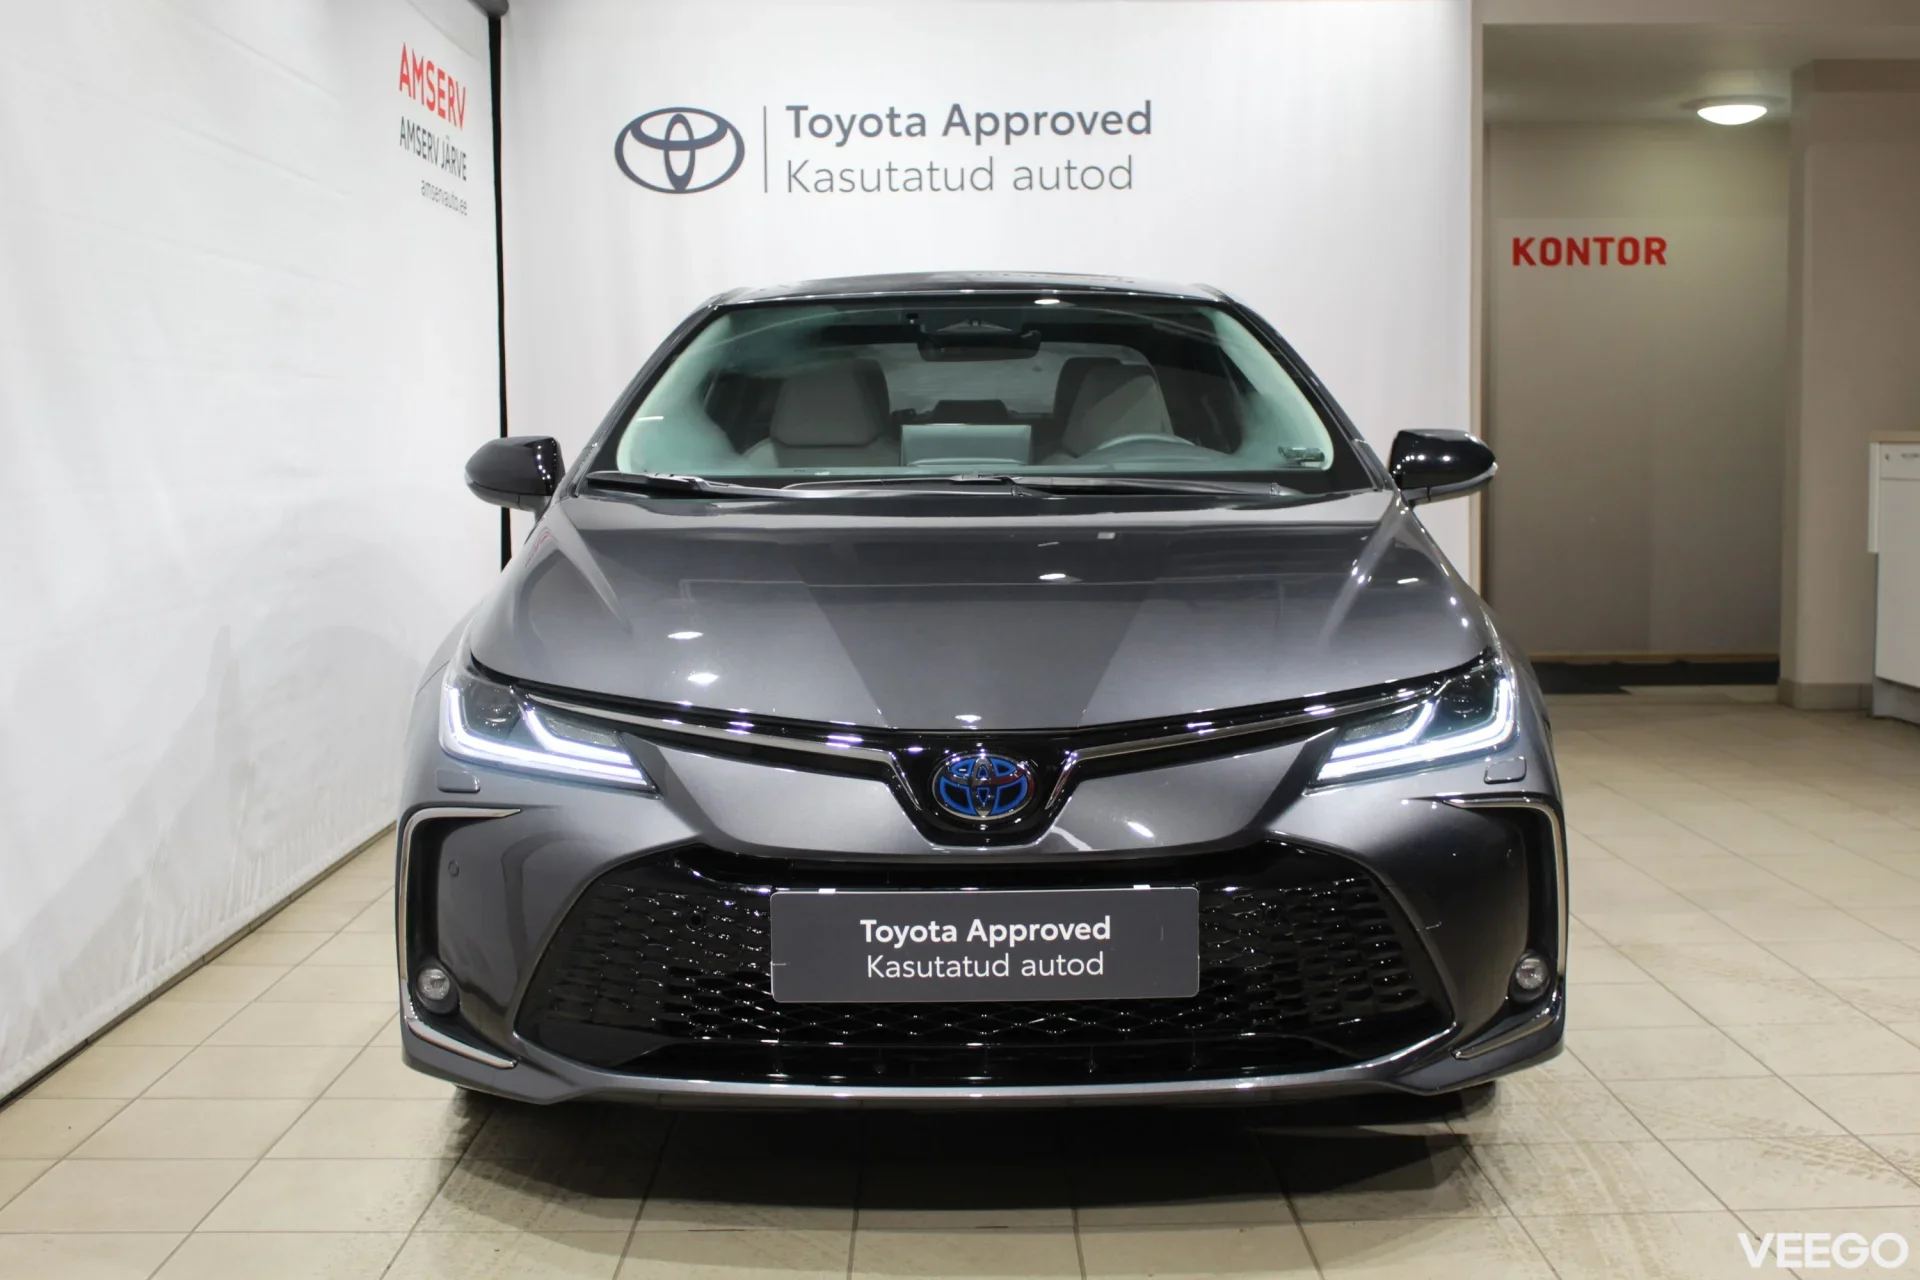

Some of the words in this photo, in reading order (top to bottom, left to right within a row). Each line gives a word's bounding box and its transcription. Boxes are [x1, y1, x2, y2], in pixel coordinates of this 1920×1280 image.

[399, 42, 466, 129] AMSERV
[786, 105, 927, 147] Toyota
[942, 100, 1152, 145] Approved
[400, 116, 439, 165] AMSERV
[441, 135, 467, 181] JÄRVE
[787, 156, 994, 193] Kasutatud
[1013, 155, 1133, 191] autod
[1512, 236, 1667, 266] KONTOR
[860, 919, 957, 948] Toyota
[967, 915, 1111, 947] Approved
[867, 953, 1010, 978] Kasutatud
[1021, 951, 1104, 976] autod
